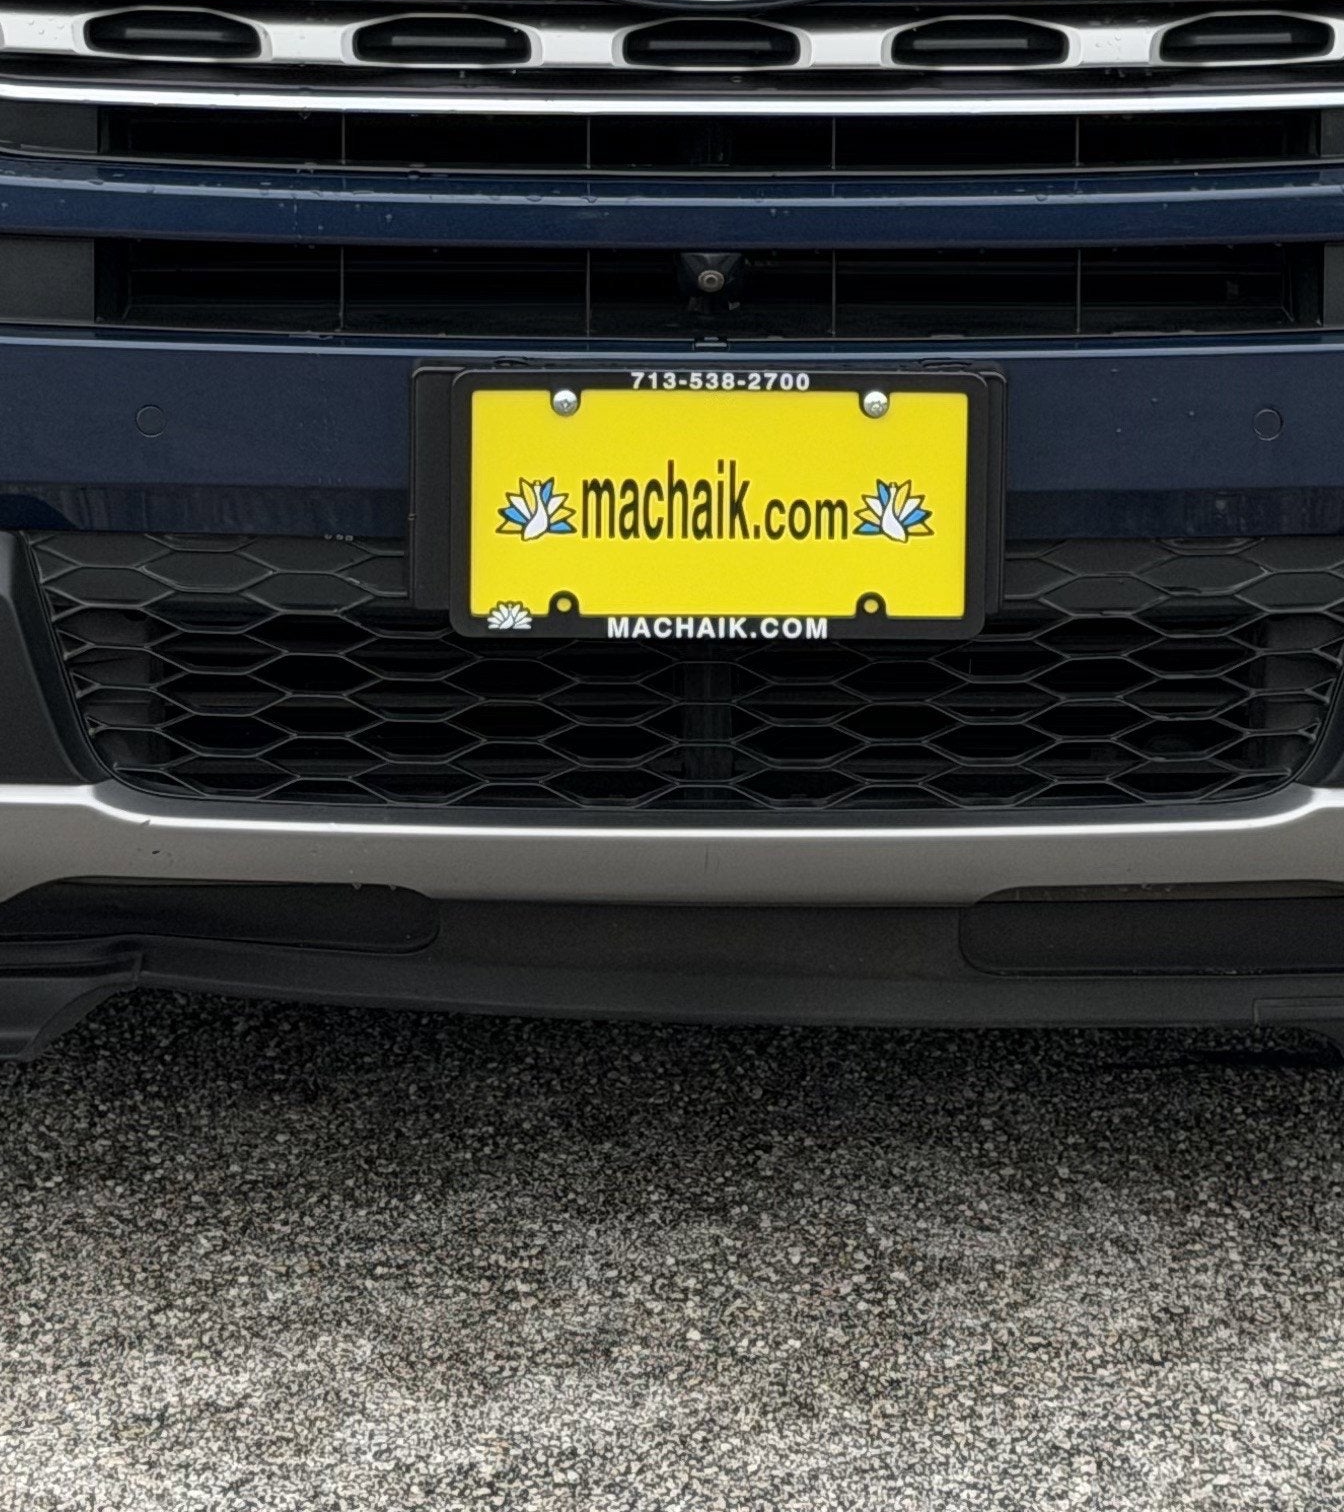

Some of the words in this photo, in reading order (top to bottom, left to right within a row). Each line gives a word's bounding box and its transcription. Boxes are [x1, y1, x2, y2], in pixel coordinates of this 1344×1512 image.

[630, 372, 810, 391] 713-538-2700
[581, 458, 849, 541] machaik.com
[606, 616, 829, 640] MACHAIK.COM
